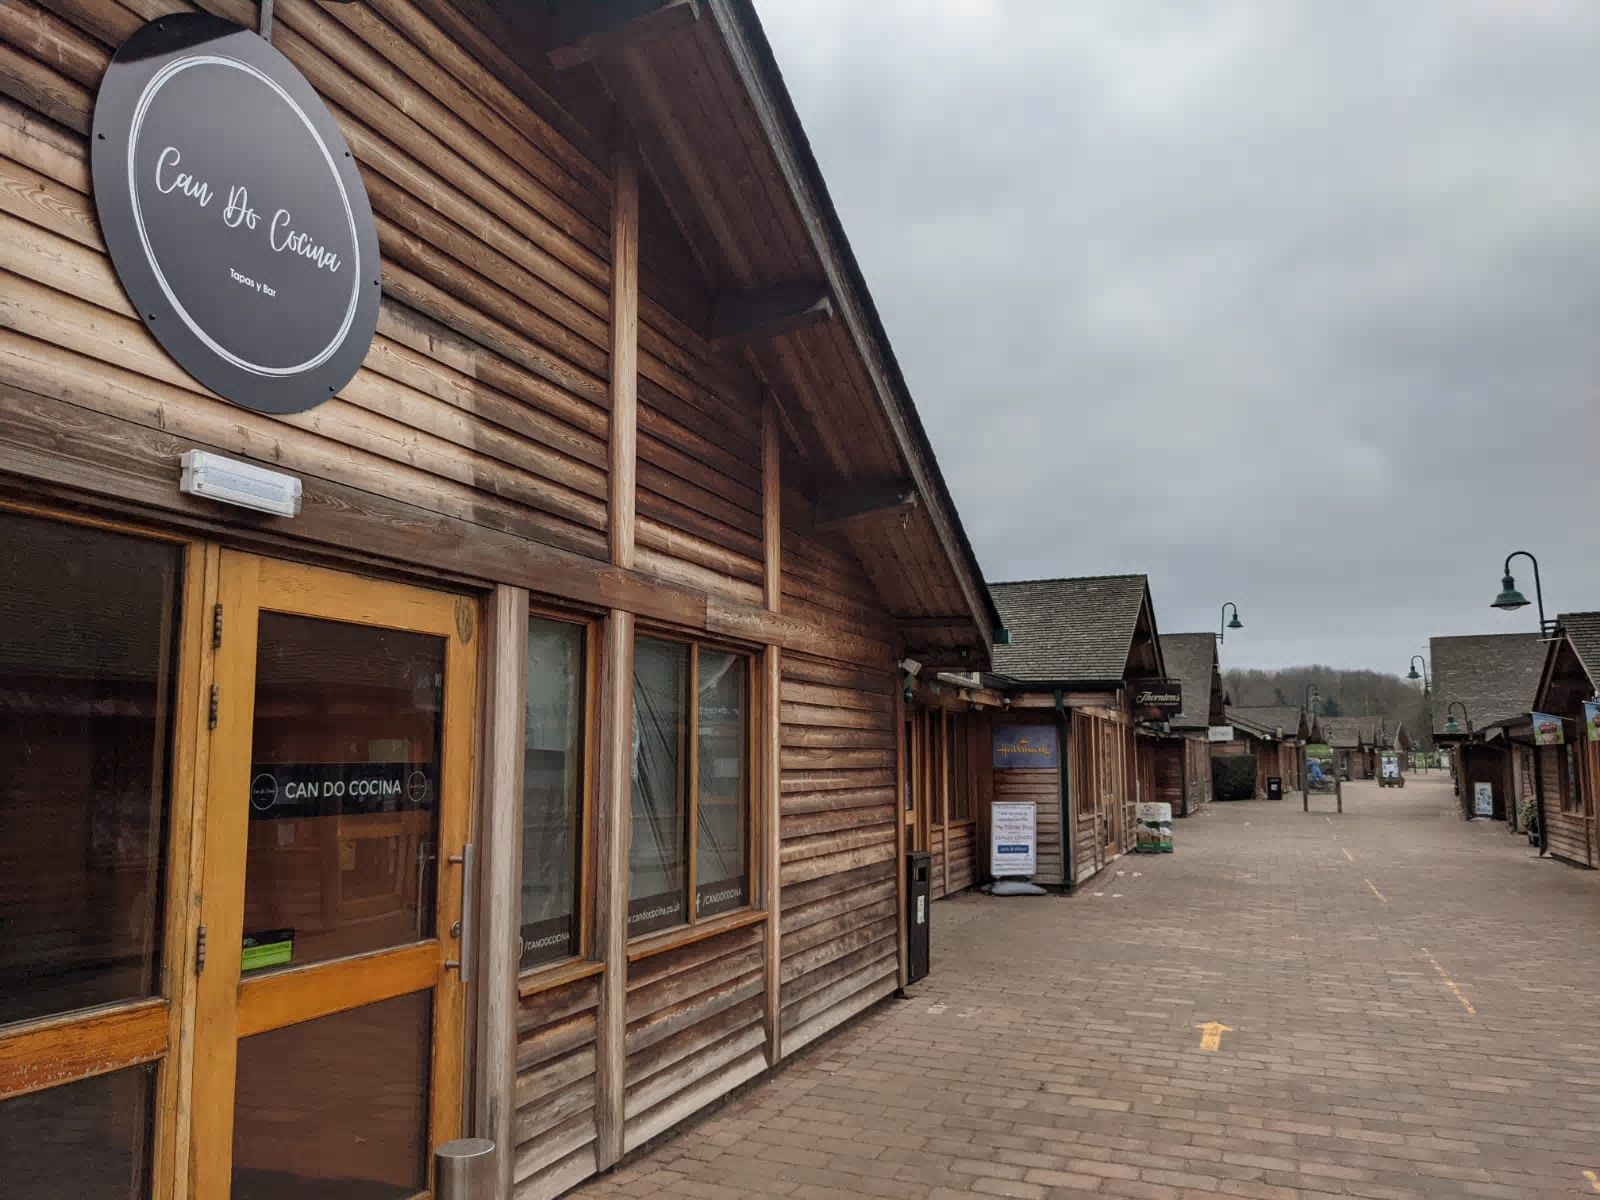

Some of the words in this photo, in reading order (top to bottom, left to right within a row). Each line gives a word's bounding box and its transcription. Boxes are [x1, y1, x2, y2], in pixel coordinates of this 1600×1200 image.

[155, 146, 214, 207] Can
[223, 184, 262, 230] Do
[269, 208, 342, 273] Cocina
[229, 267, 255, 288] Tapas
[256, 281, 262, 292] y
[262, 283, 277, 297] Bar
[1135, 691, 1180, 704] Thorntons
[284, 781, 320, 799] CAN
[323, 780, 346, 797] DO
[348, 779, 402, 796] COCINA
